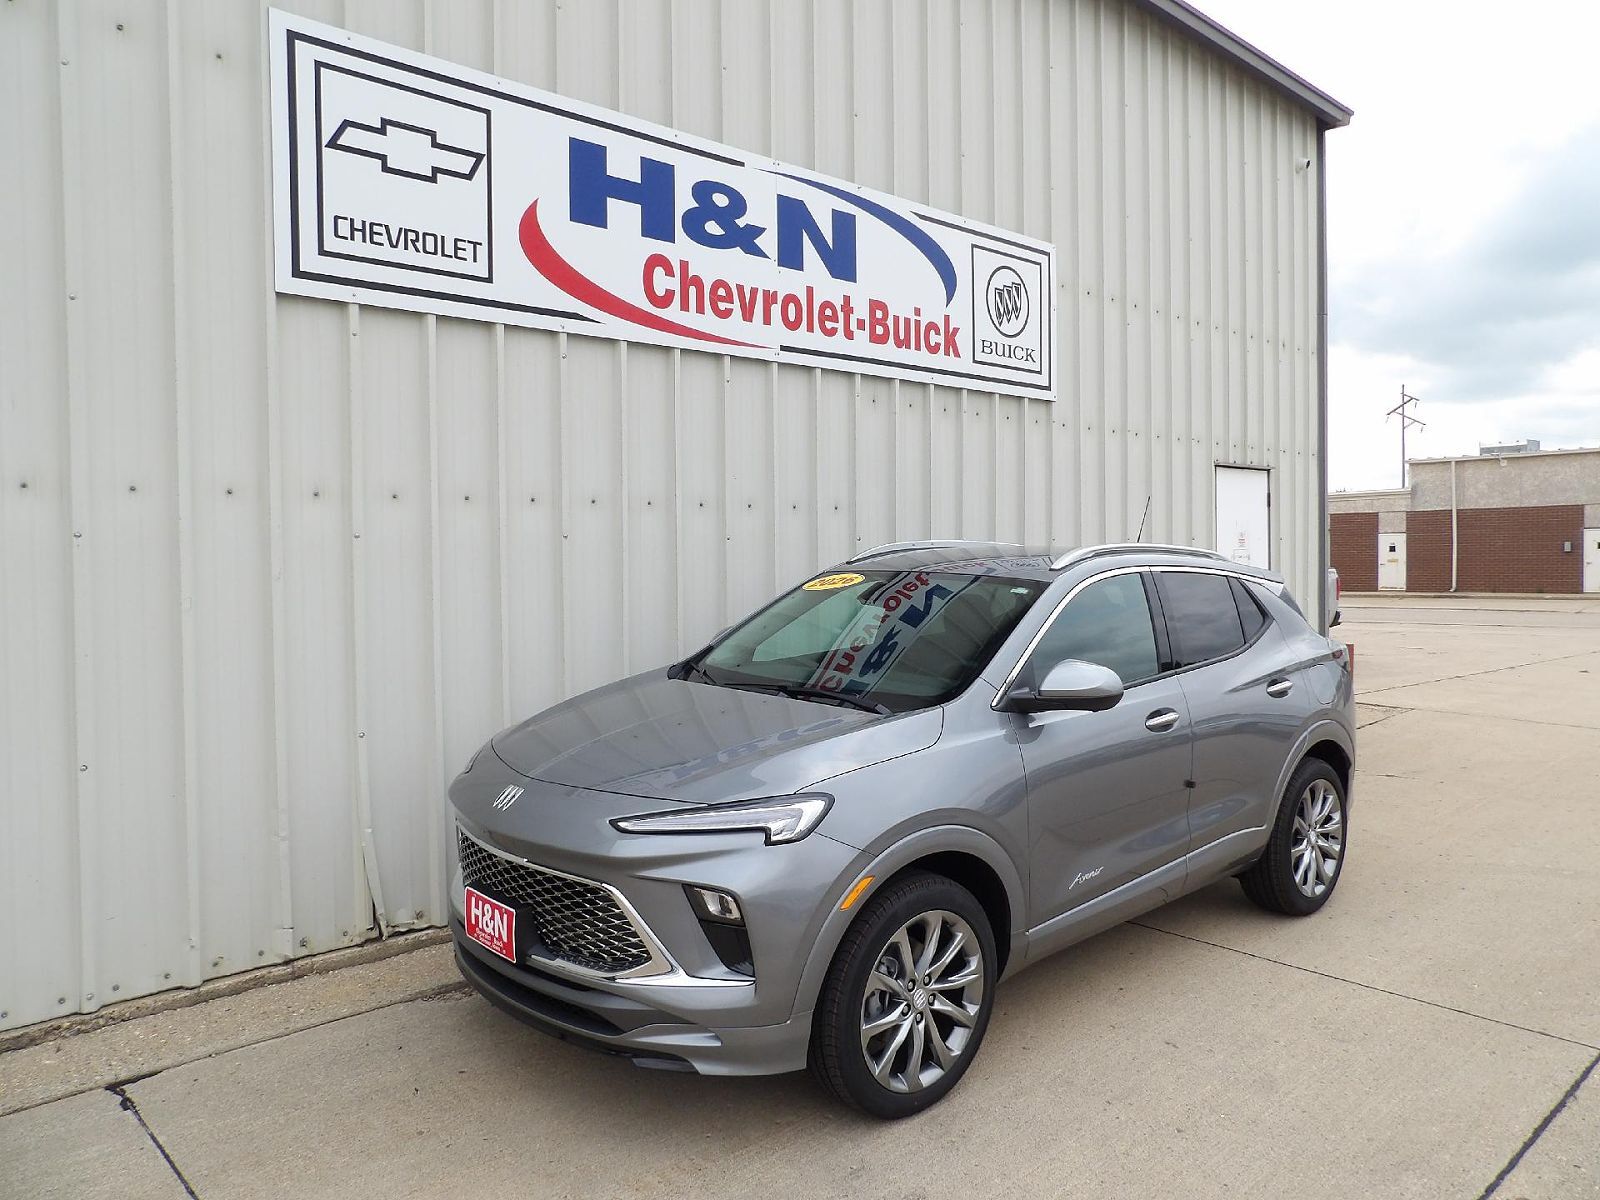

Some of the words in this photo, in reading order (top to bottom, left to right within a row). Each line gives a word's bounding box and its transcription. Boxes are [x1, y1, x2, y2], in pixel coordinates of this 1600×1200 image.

[568, 136, 857, 283] H&N
[333, 215, 483, 263] CHEVROLET
[642, 252, 962, 358] Chevrolet-Buick
[980, 339, 1036, 363] BUICK
[471, 896, 508, 943] H&N
